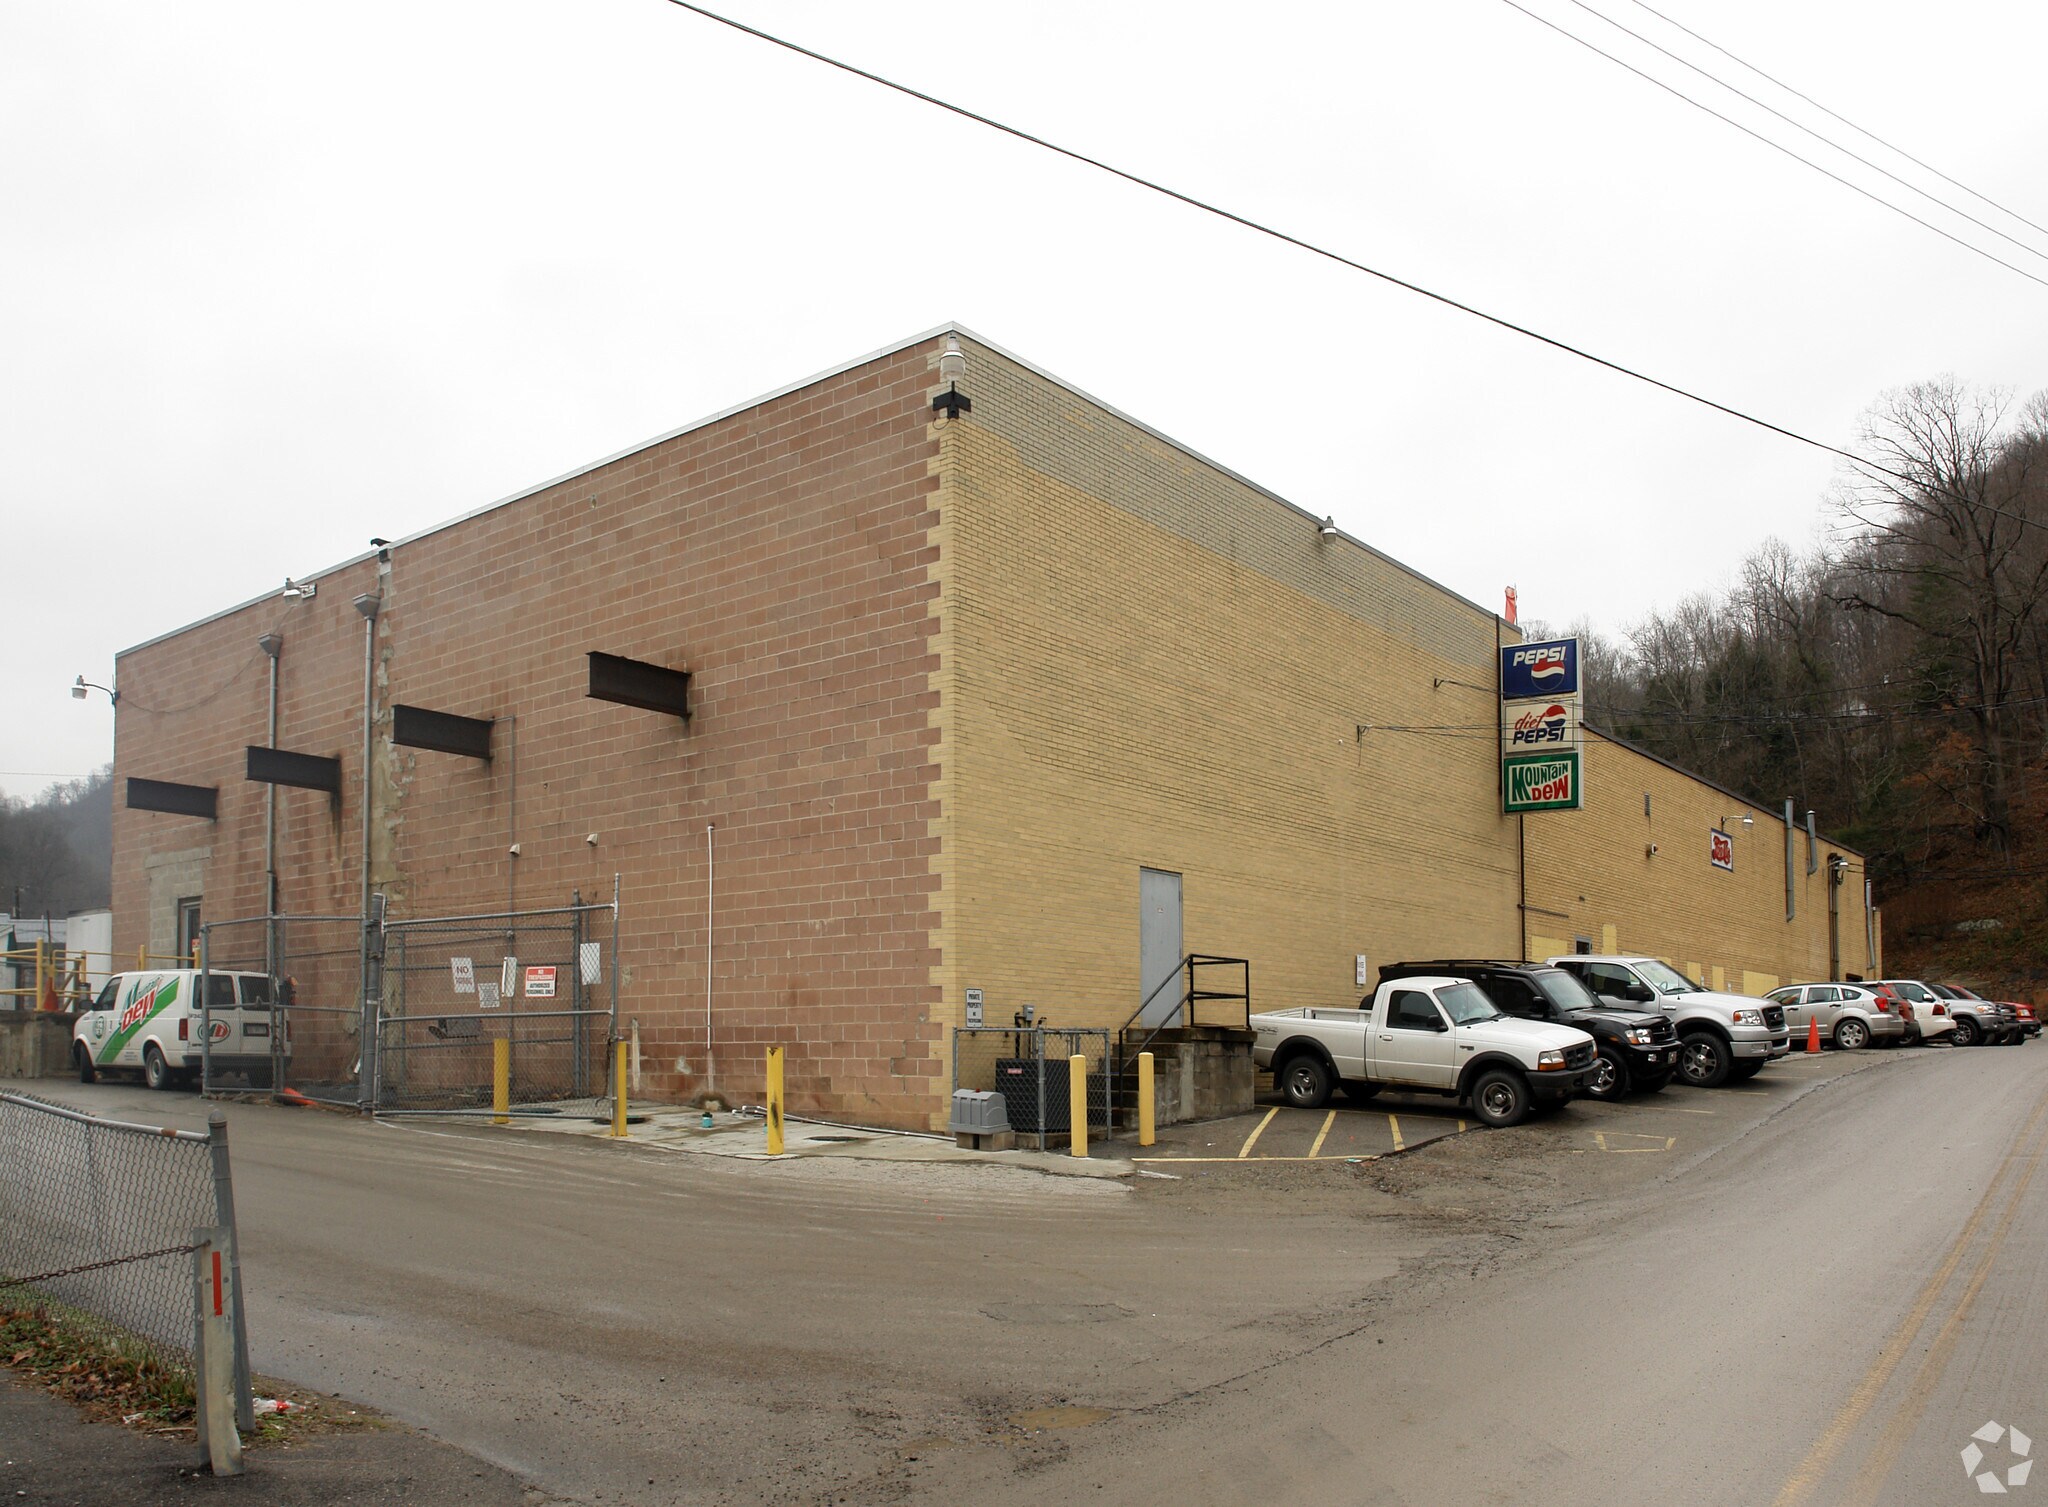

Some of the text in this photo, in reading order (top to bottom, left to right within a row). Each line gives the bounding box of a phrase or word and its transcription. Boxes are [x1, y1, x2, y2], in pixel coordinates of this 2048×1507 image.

[1512, 645, 1567, 667] PEPSI
[1514, 711, 1545, 731] diet
[1512, 726, 1565, 745] PEPSI
[456, 965, 470, 974] NO
